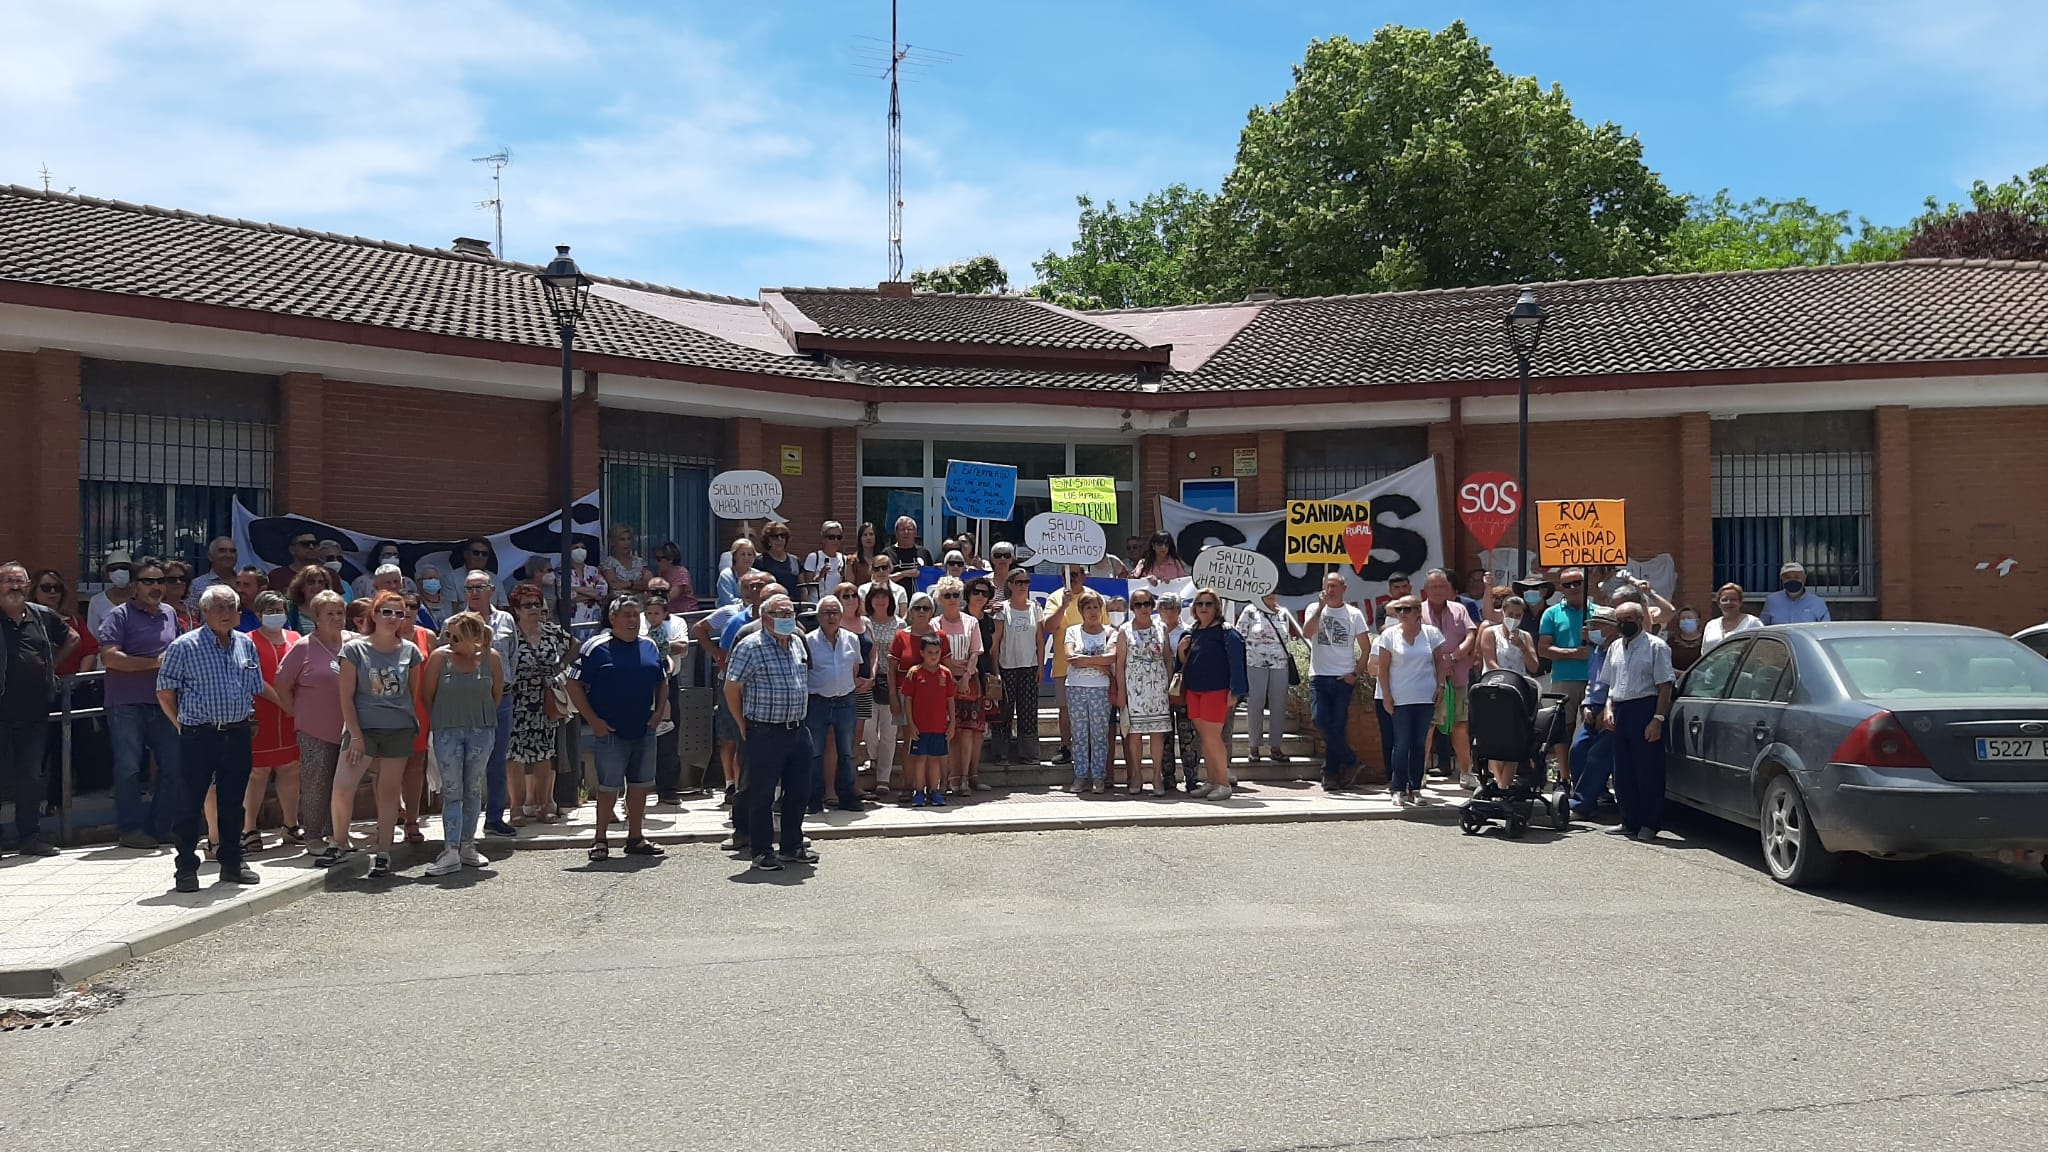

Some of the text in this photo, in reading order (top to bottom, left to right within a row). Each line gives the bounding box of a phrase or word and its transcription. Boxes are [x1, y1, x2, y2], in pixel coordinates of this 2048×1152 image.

[1213, 467, 1220, 476] 2
[713, 483, 780, 496] SALUD MENTAL
[1461, 481, 1518, 514] SOS
[1291, 502, 1368, 525] SANIDAD
[1557, 501, 1599, 521] ROA
[1048, 519, 1086, 531] SALUD
[1346, 525, 1371, 536] RURAL
[1042, 532, 1090, 542] MENTAL
[1287, 533, 1347, 555] DIGNA
[1544, 528, 1616, 549] SANIDAD
[1216, 551, 1255, 566] SALUD
[1209, 561, 1260, 579] MENTAL
[1195, 573, 1272, 595] ¿HABLAMOS?
[1990, 740, 2032, 757] 5227
